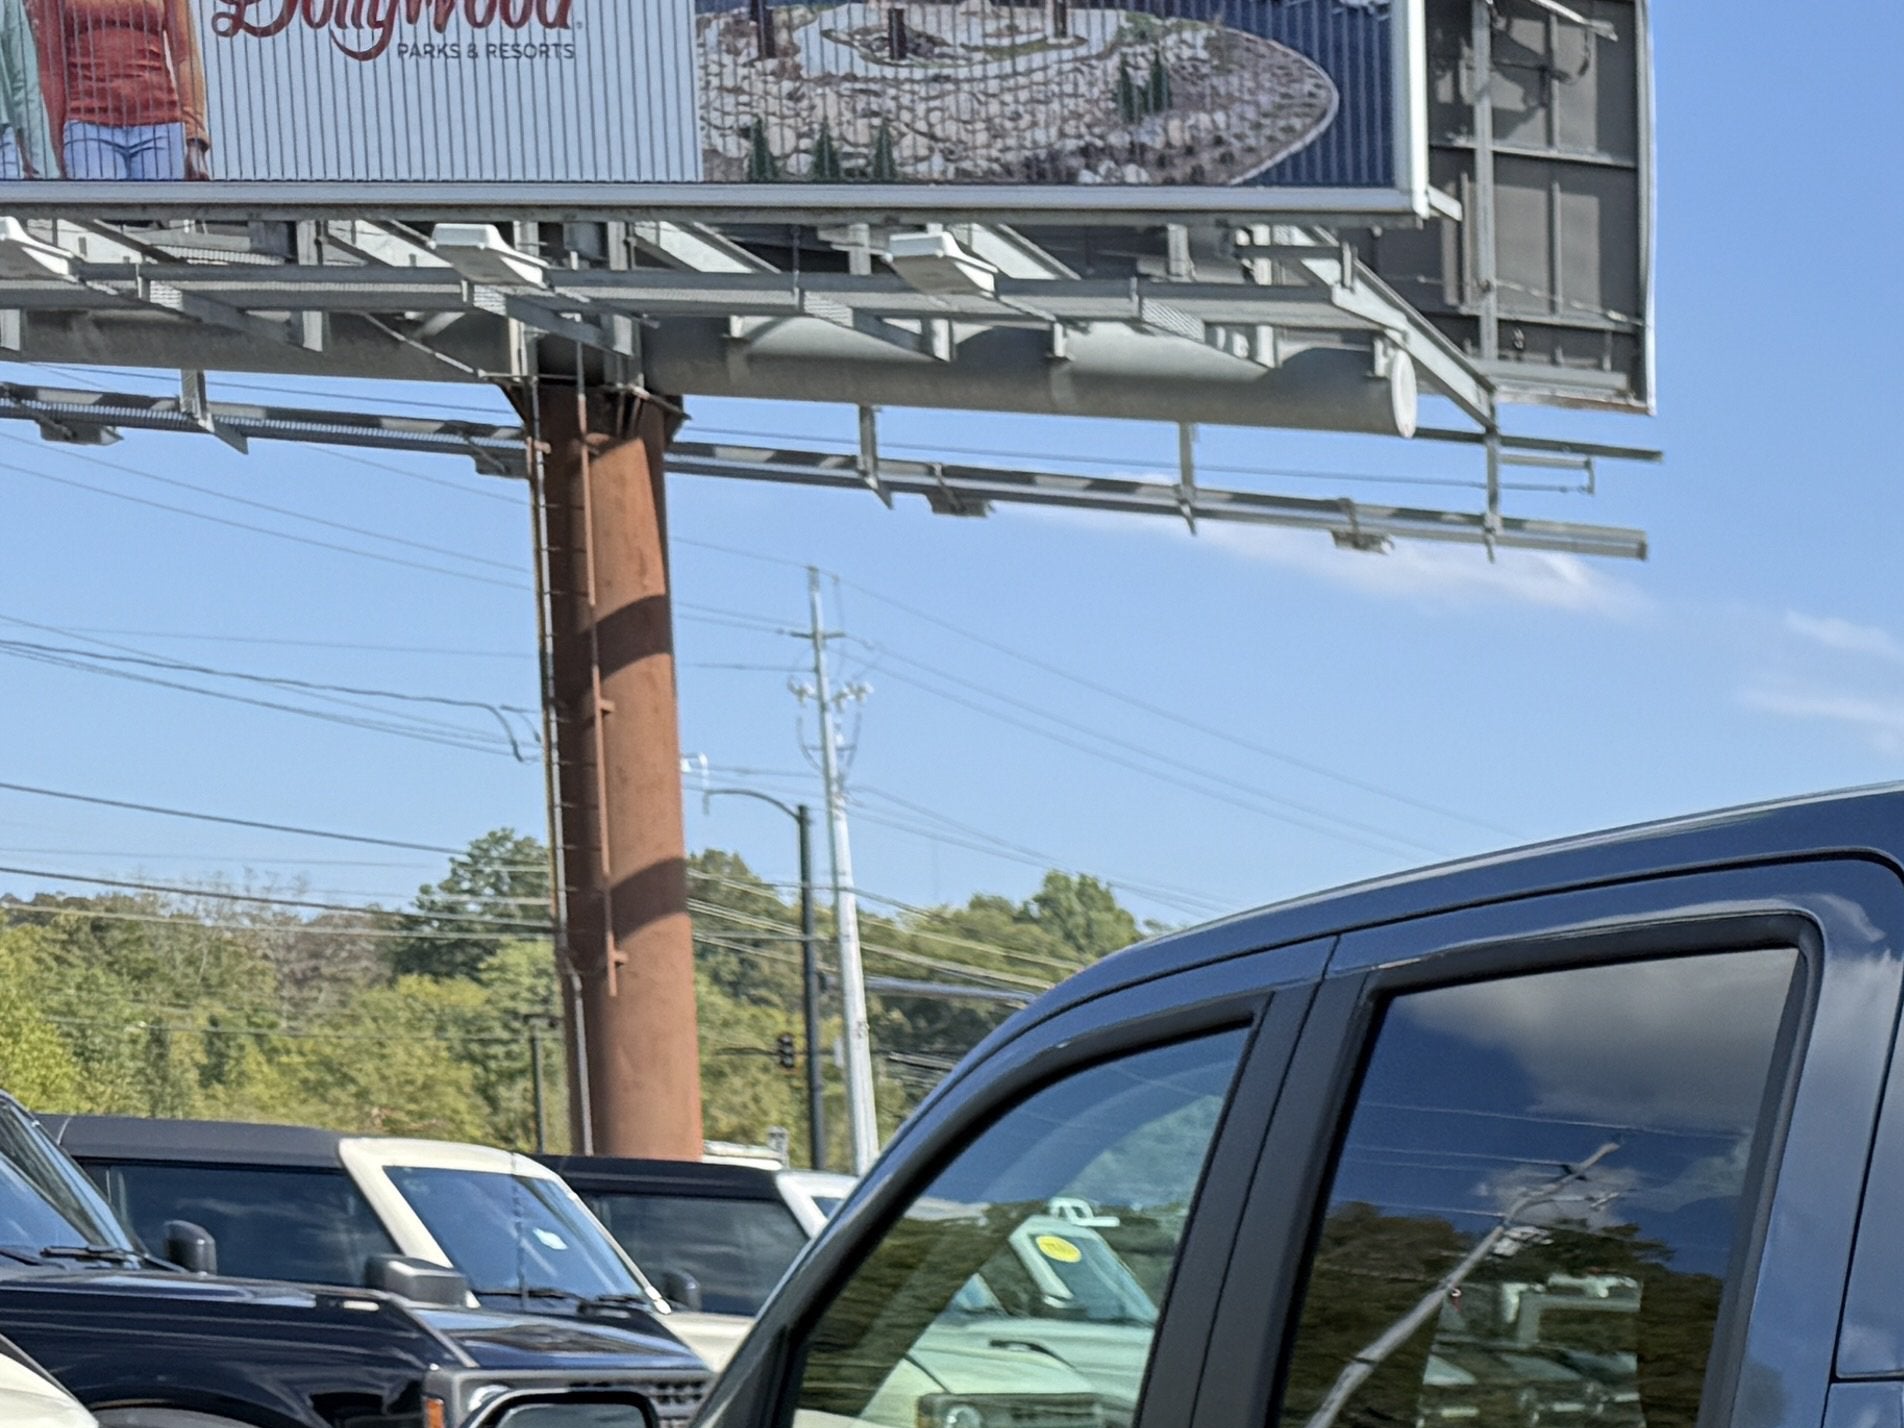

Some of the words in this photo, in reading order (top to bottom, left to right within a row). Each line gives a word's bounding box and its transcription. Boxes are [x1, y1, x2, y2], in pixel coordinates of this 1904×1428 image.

[397, 43, 462, 59] PARKS
[467, 43, 479, 59] &
[486, 43, 576, 59] RESORTS
